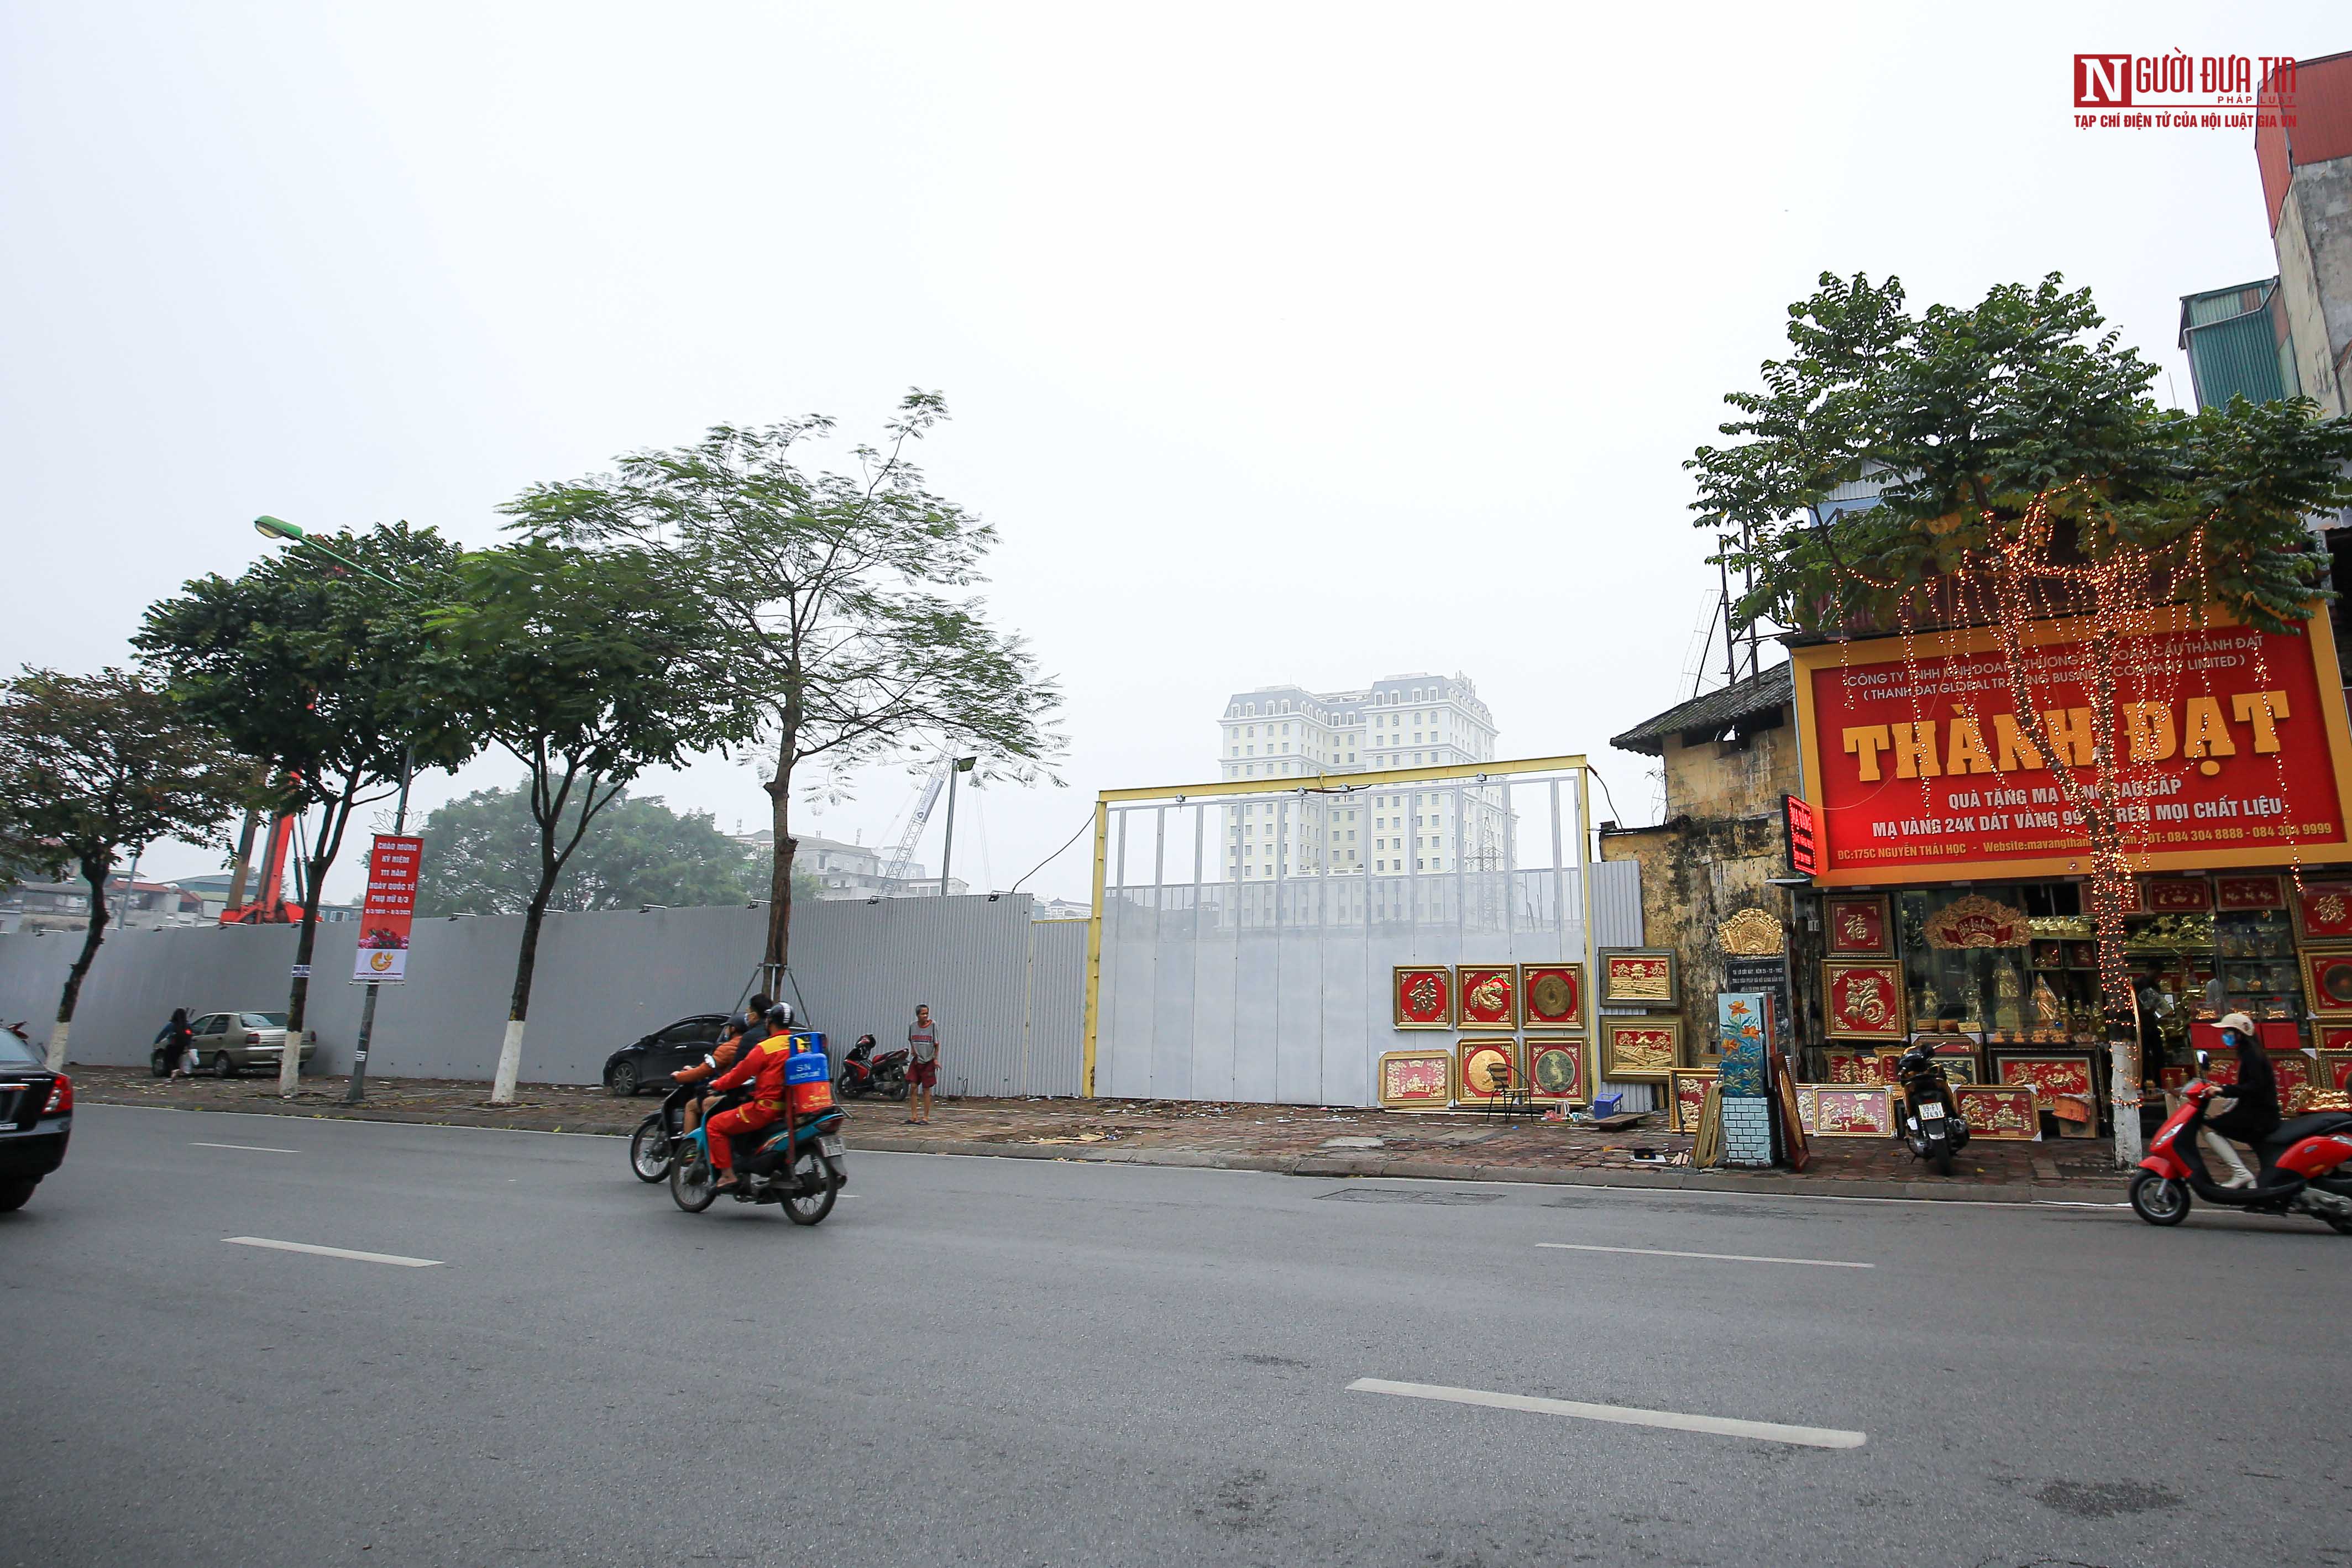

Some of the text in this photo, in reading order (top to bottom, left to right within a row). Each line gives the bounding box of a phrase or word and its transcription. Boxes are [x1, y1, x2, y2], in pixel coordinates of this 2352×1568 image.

[1848, 673, 1888, 686] CÔNG
[1890, 672, 1904, 683] TY
[2185, 638, 2233, 654] THÀNH
[2187, 655, 2237, 670] LIMITED
[1842, 690, 2291, 782] THÀNH ĐẠT
[1872, 821, 1898, 840] MẠ
[1900, 817, 1942, 835] VÀNG
[1945, 816, 1976, 833] 24K
[1979, 812, 2009, 831] DÁT
[2014, 809, 2058, 829] VÀNG
[2156, 804, 2189, 823] MỌI
[2193, 794, 2238, 819] CHẤT
[2242, 795, 2282, 818] LIỆU
[1948, 789, 1981, 810] QUÀ
[1984, 788, 2028, 809] TẶNG
[2032, 787, 2060, 806] MẠ
[1837, 849, 1876, 860] ĐC:175C
[1878, 842, 1918, 858] NGUYỄN
[1919, 842, 1944, 856] THÁI
[1946, 843, 1966, 856] HỌC
[2168, 831, 2188, 843] 084
[2191, 830, 2213, 842] 304
[2215, 828, 2244, 840] 8888
[2253, 826, 2275, 838] 084
[2278, 824, 2299, 836] 304
[2302, 823, 2332, 835] 9999
